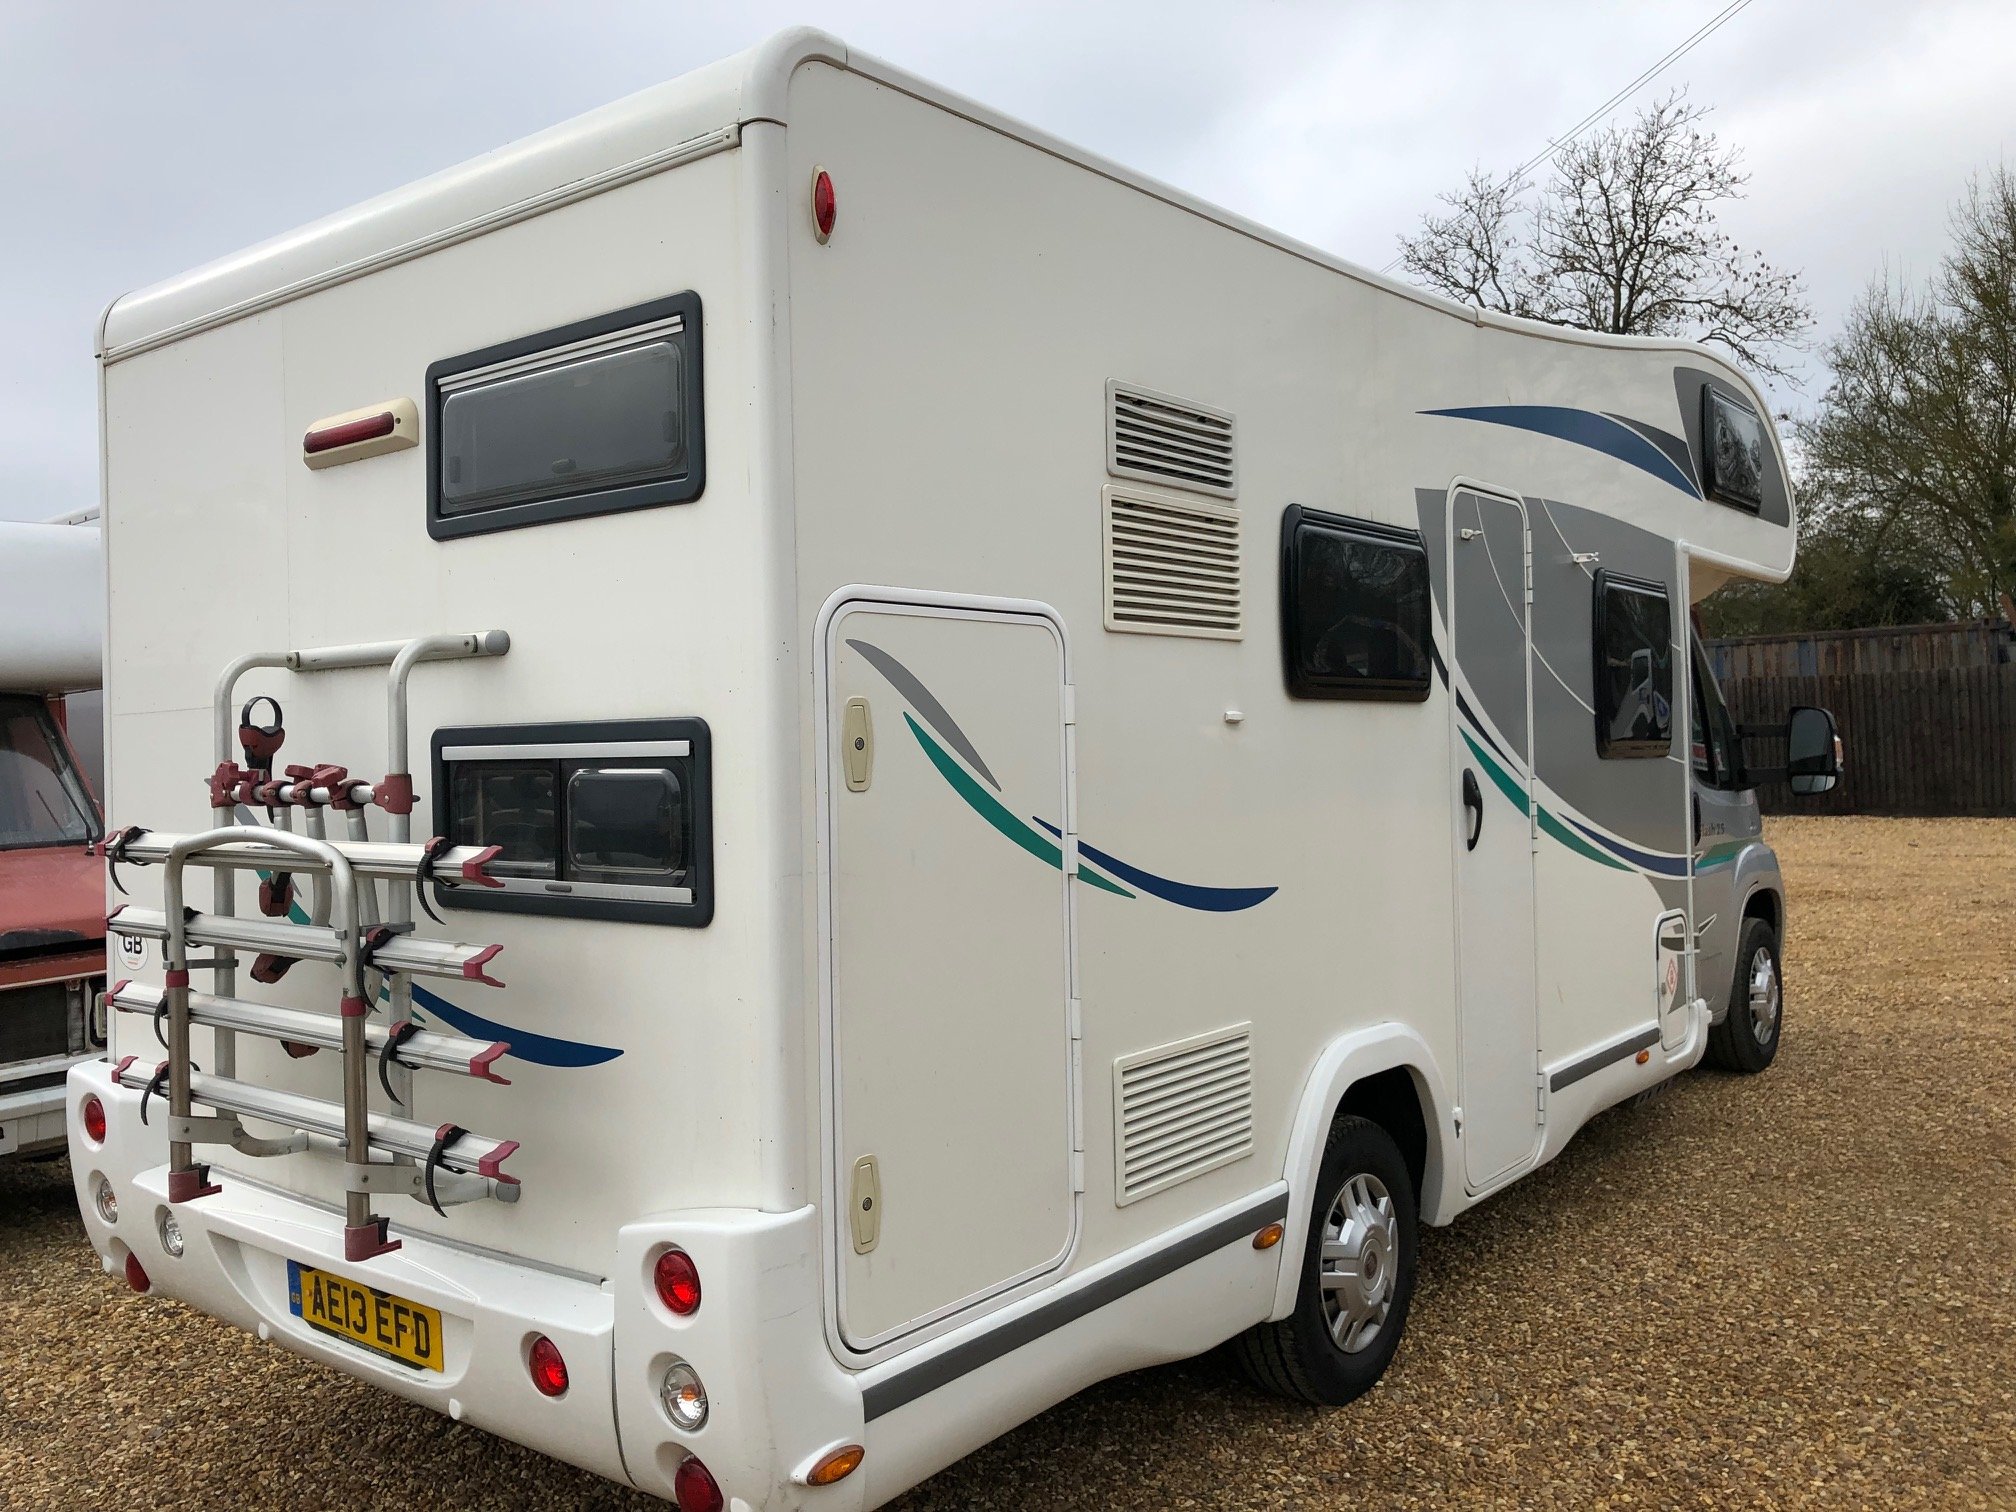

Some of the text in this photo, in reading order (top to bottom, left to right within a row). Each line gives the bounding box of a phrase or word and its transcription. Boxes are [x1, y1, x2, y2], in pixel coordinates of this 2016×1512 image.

[122, 935, 143, 955] GB
[312, 1275, 367, 1335] AE13
[375, 1297, 431, 1359] EFD
